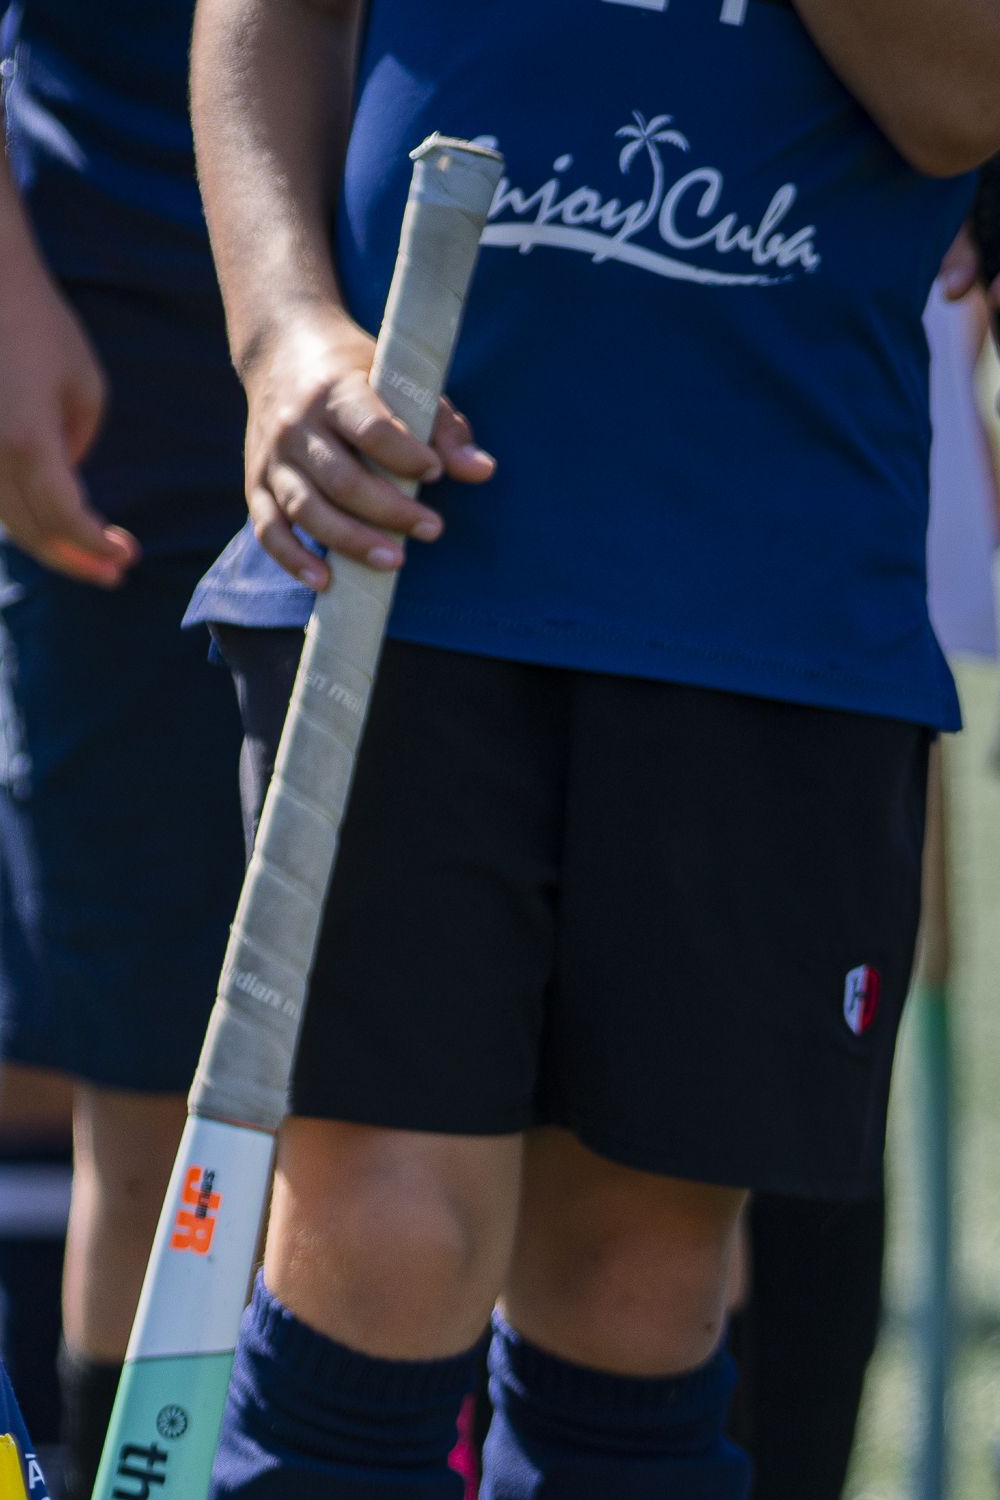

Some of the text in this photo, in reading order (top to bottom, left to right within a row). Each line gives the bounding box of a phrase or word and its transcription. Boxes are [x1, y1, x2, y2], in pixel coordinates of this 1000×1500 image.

[471, 135, 822, 272] njoy Cuba
[170, 1164, 222, 1256] JR
